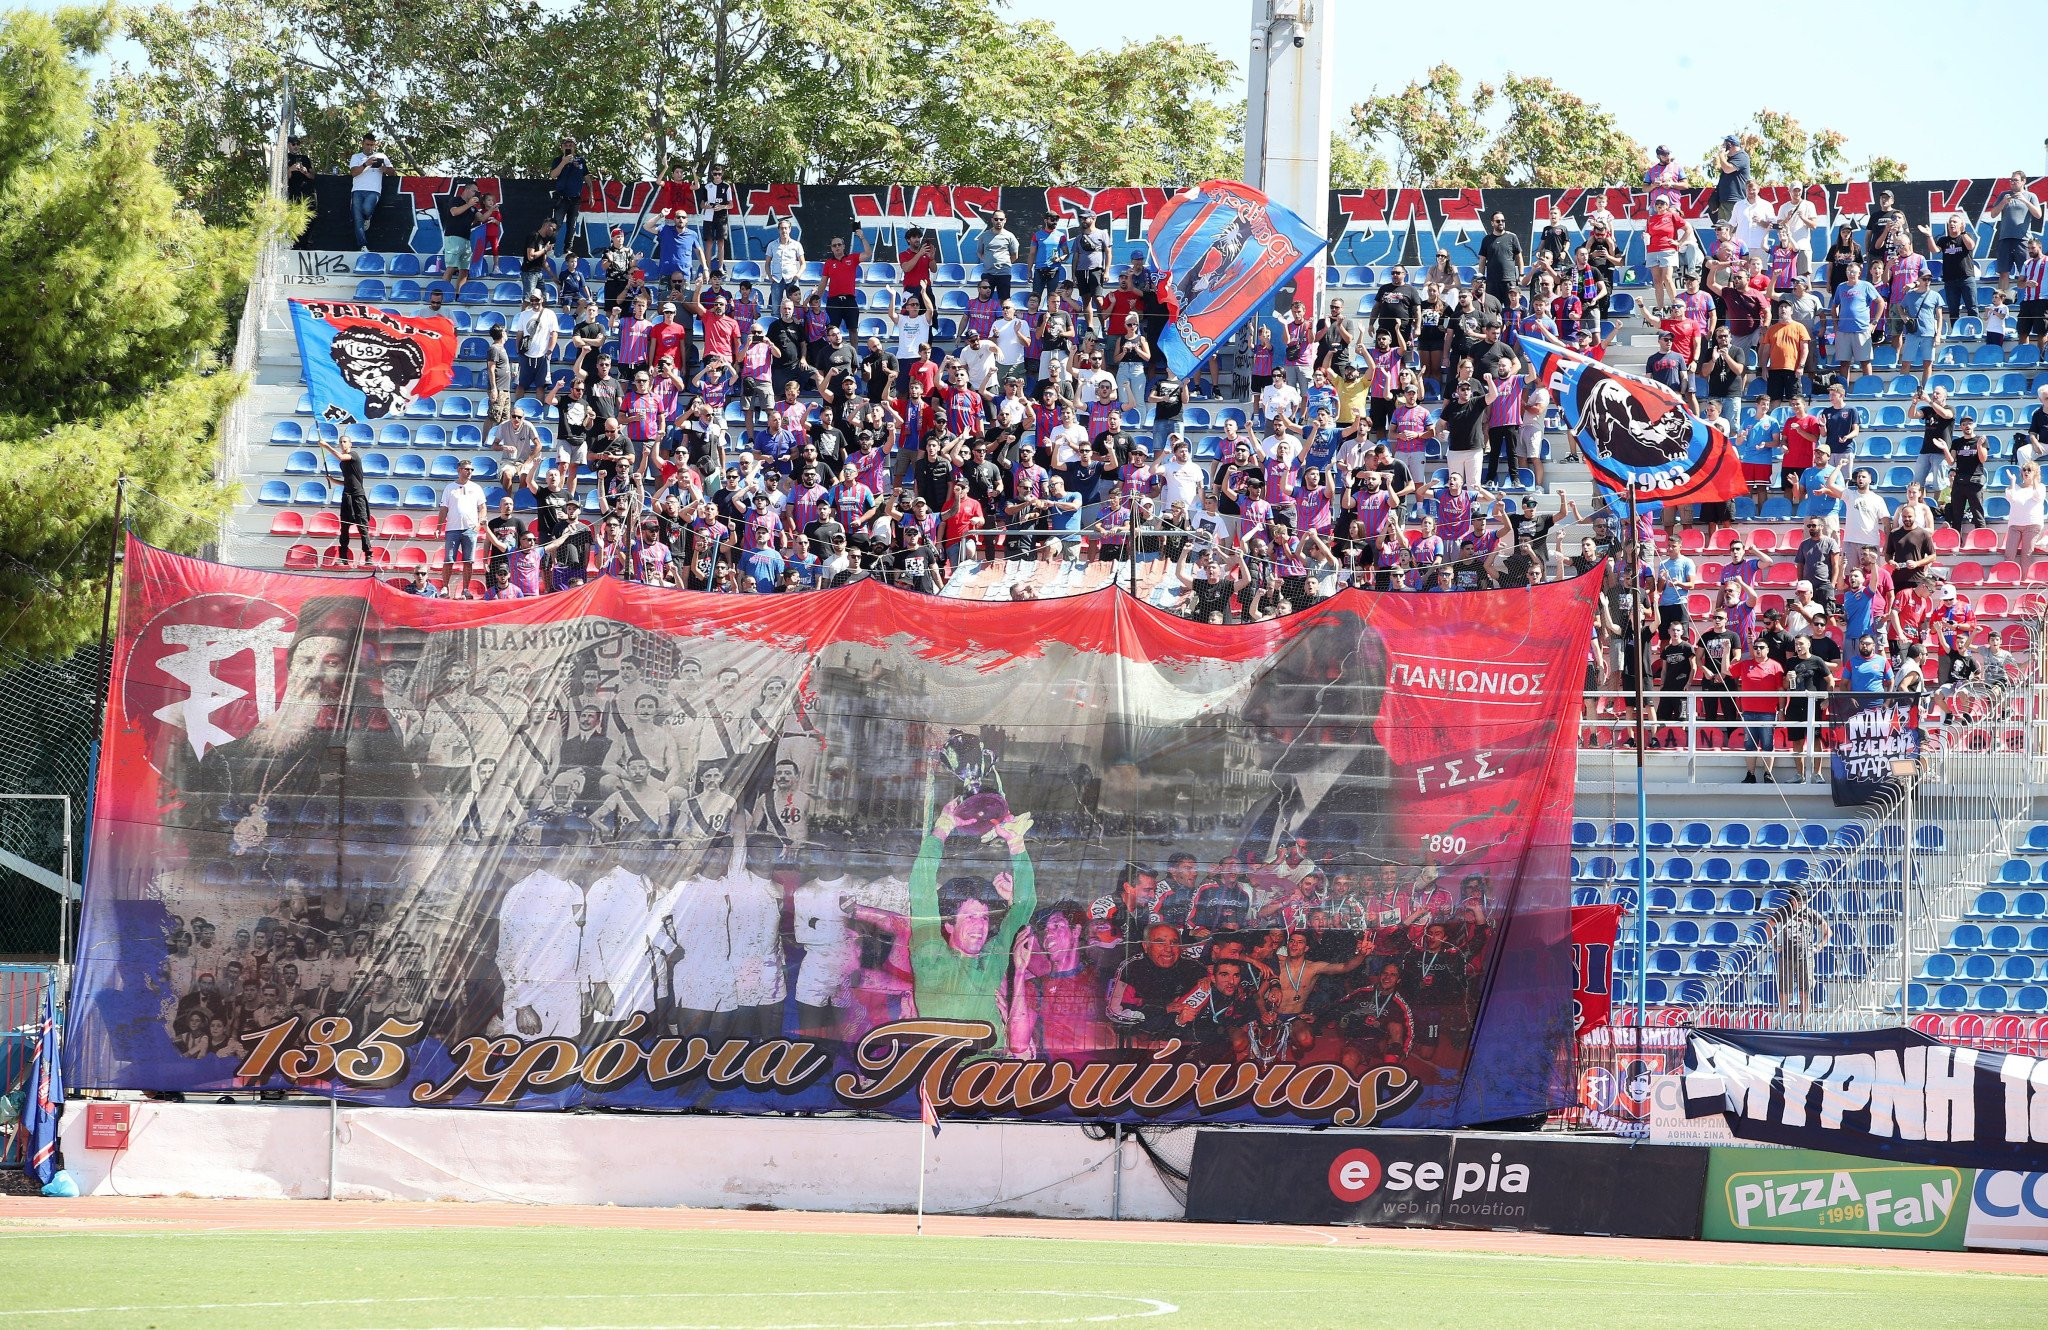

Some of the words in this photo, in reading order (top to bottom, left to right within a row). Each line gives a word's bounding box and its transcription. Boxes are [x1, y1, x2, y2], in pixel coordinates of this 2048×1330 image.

[1628, 466, 1690, 493] 1983
[1390, 662, 1546, 697] ΠΑΝΙΩΝΙΟΣ
[1416, 751, 1505, 794] Γ.Σ.Σ.
[240, 1016, 423, 1081] 135
[412, 1014, 828, 1105] χρόνια
[836, 1020, 1418, 1127] Πανιώνιος
[1704, 1131, 1725, 1140] ΣΙΝΑ
[1383, 1201, 1419, 1214] web
[1826, 1203, 1865, 1224] 1996
